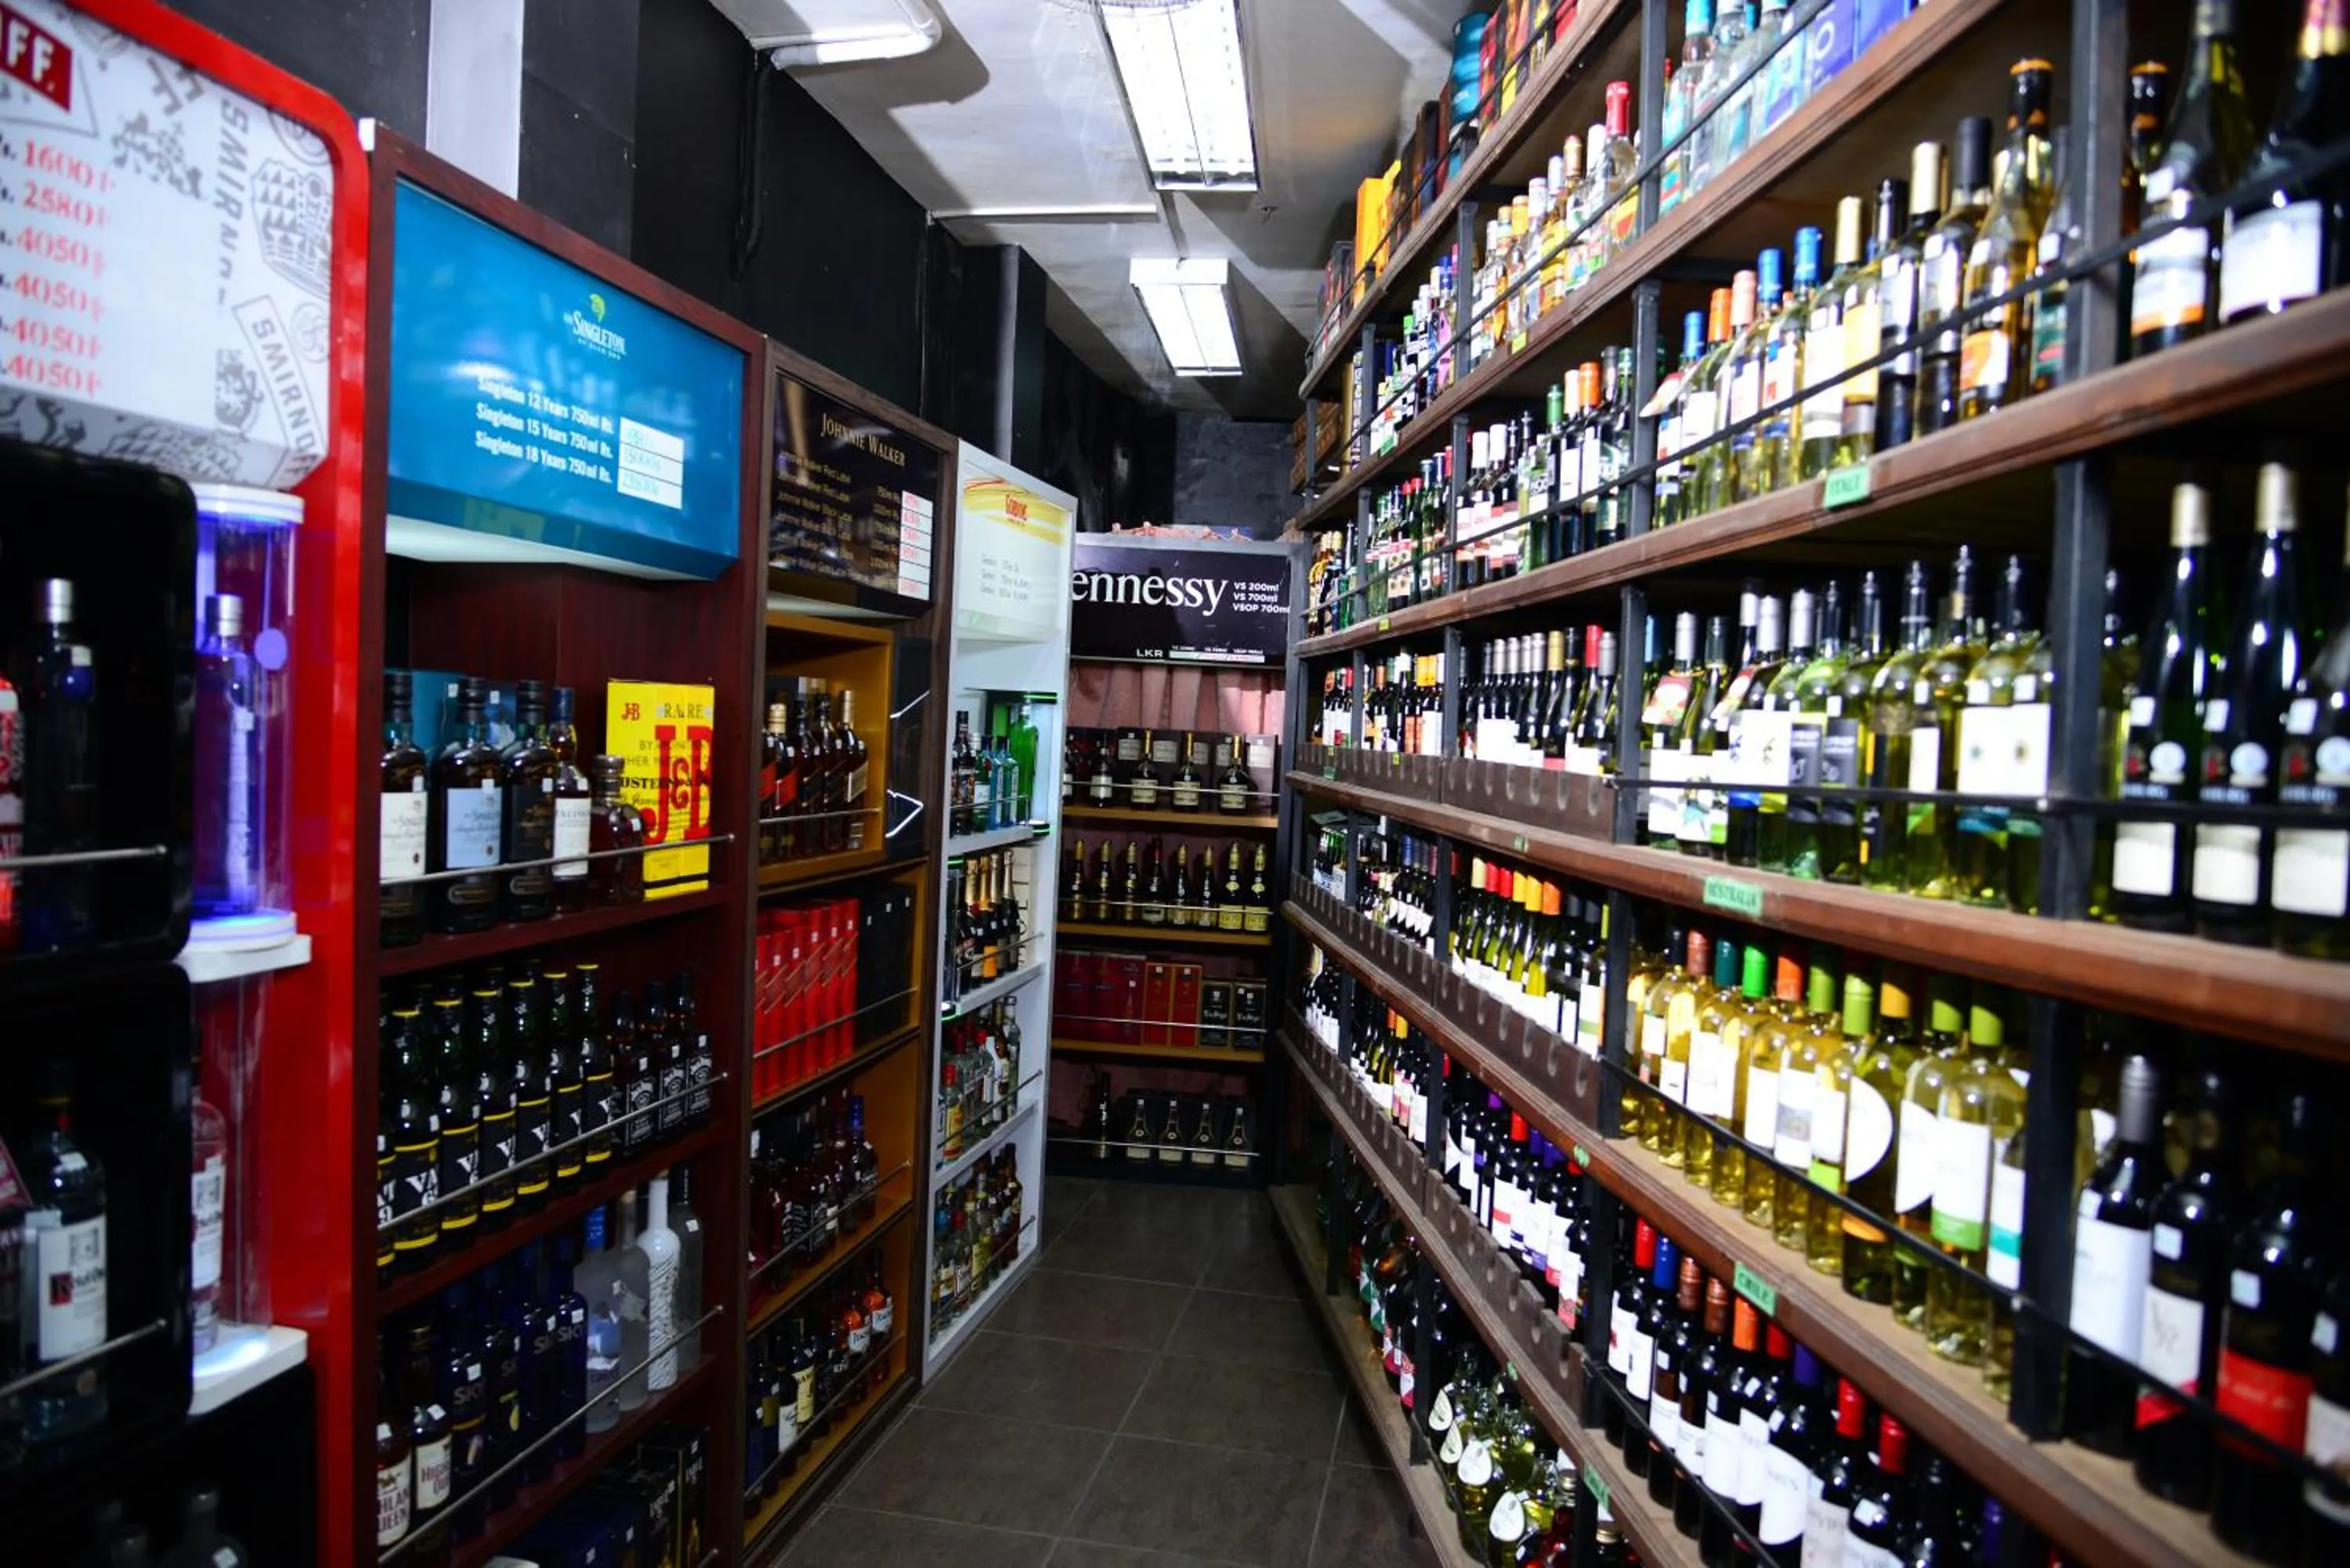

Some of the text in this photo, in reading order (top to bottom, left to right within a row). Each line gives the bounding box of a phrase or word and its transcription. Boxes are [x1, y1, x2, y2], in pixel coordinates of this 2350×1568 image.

[528, 392, 541, 409] 12
[543, 396, 569, 418] Years
[476, 402, 524, 431] Singleton
[527, 418, 540, 436] 15
[542, 423, 567, 445] Years
[570, 432, 598, 453] 750ml
[475, 431, 523, 458] Singleton
[526, 446, 538, 463] 18
[541, 449, 566, 470] Years
[569, 457, 597, 479] 750ml
[869, 434, 905, 468] WALKER
[1072, 571, 1228, 616] ennessy
[1233, 591, 1278, 602] VS 700ml
[1249, 582, 1279, 591] 200ml
[1232, 603, 1259, 612] VSOP
